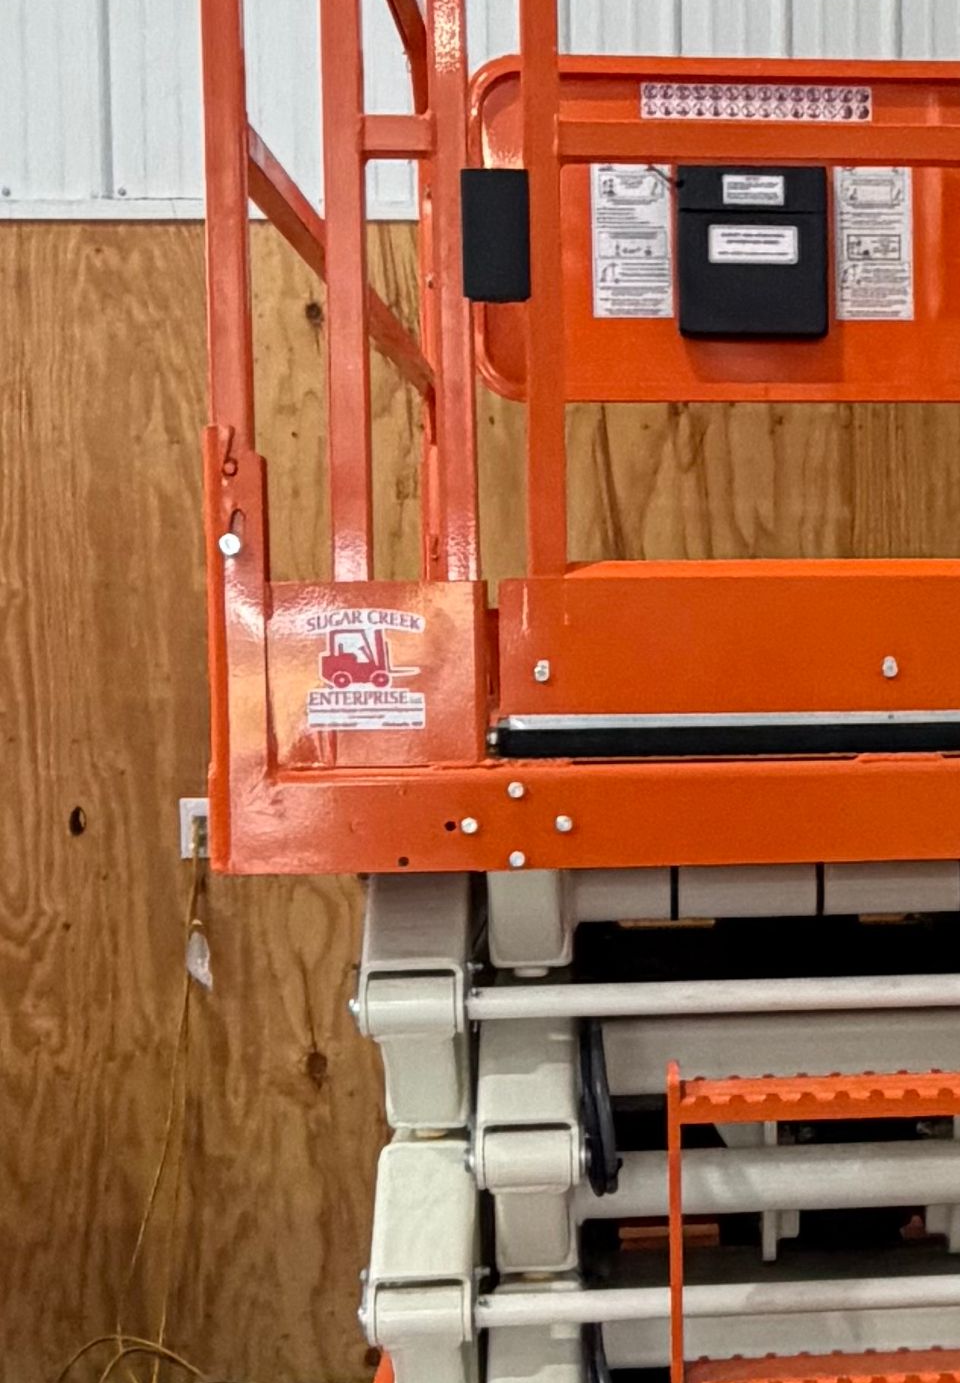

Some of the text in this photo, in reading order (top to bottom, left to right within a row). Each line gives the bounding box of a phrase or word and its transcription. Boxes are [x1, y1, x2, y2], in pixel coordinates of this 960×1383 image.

[306, 610, 421, 632] SUGAR CREEK
[309, 691, 408, 706] ENTERPRISE
